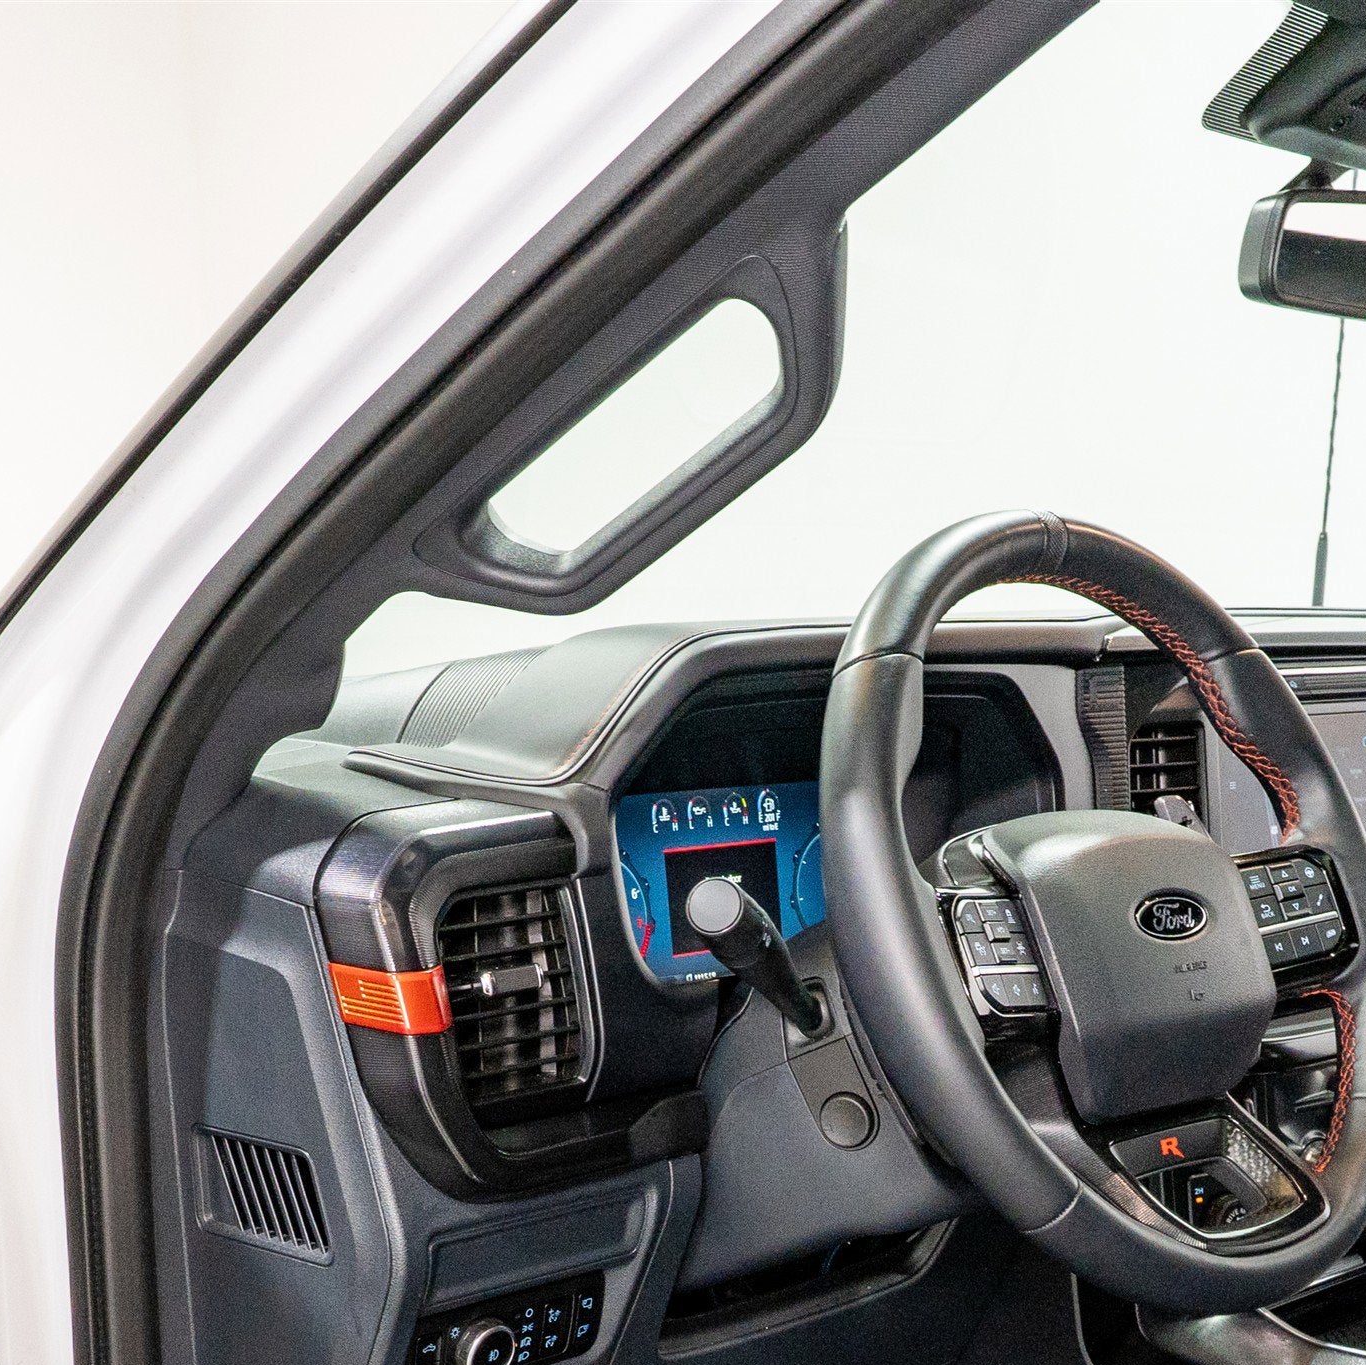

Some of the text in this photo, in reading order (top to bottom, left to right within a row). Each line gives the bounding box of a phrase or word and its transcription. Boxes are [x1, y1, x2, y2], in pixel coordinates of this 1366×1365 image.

[1250, 882, 1266, 890] MENU
[631, 888, 639, 900] 6
[1153, 903, 1195, 931] Ford
[1159, 1136, 1185, 1158] R
[1194, 1187, 1204, 1195] 2H
